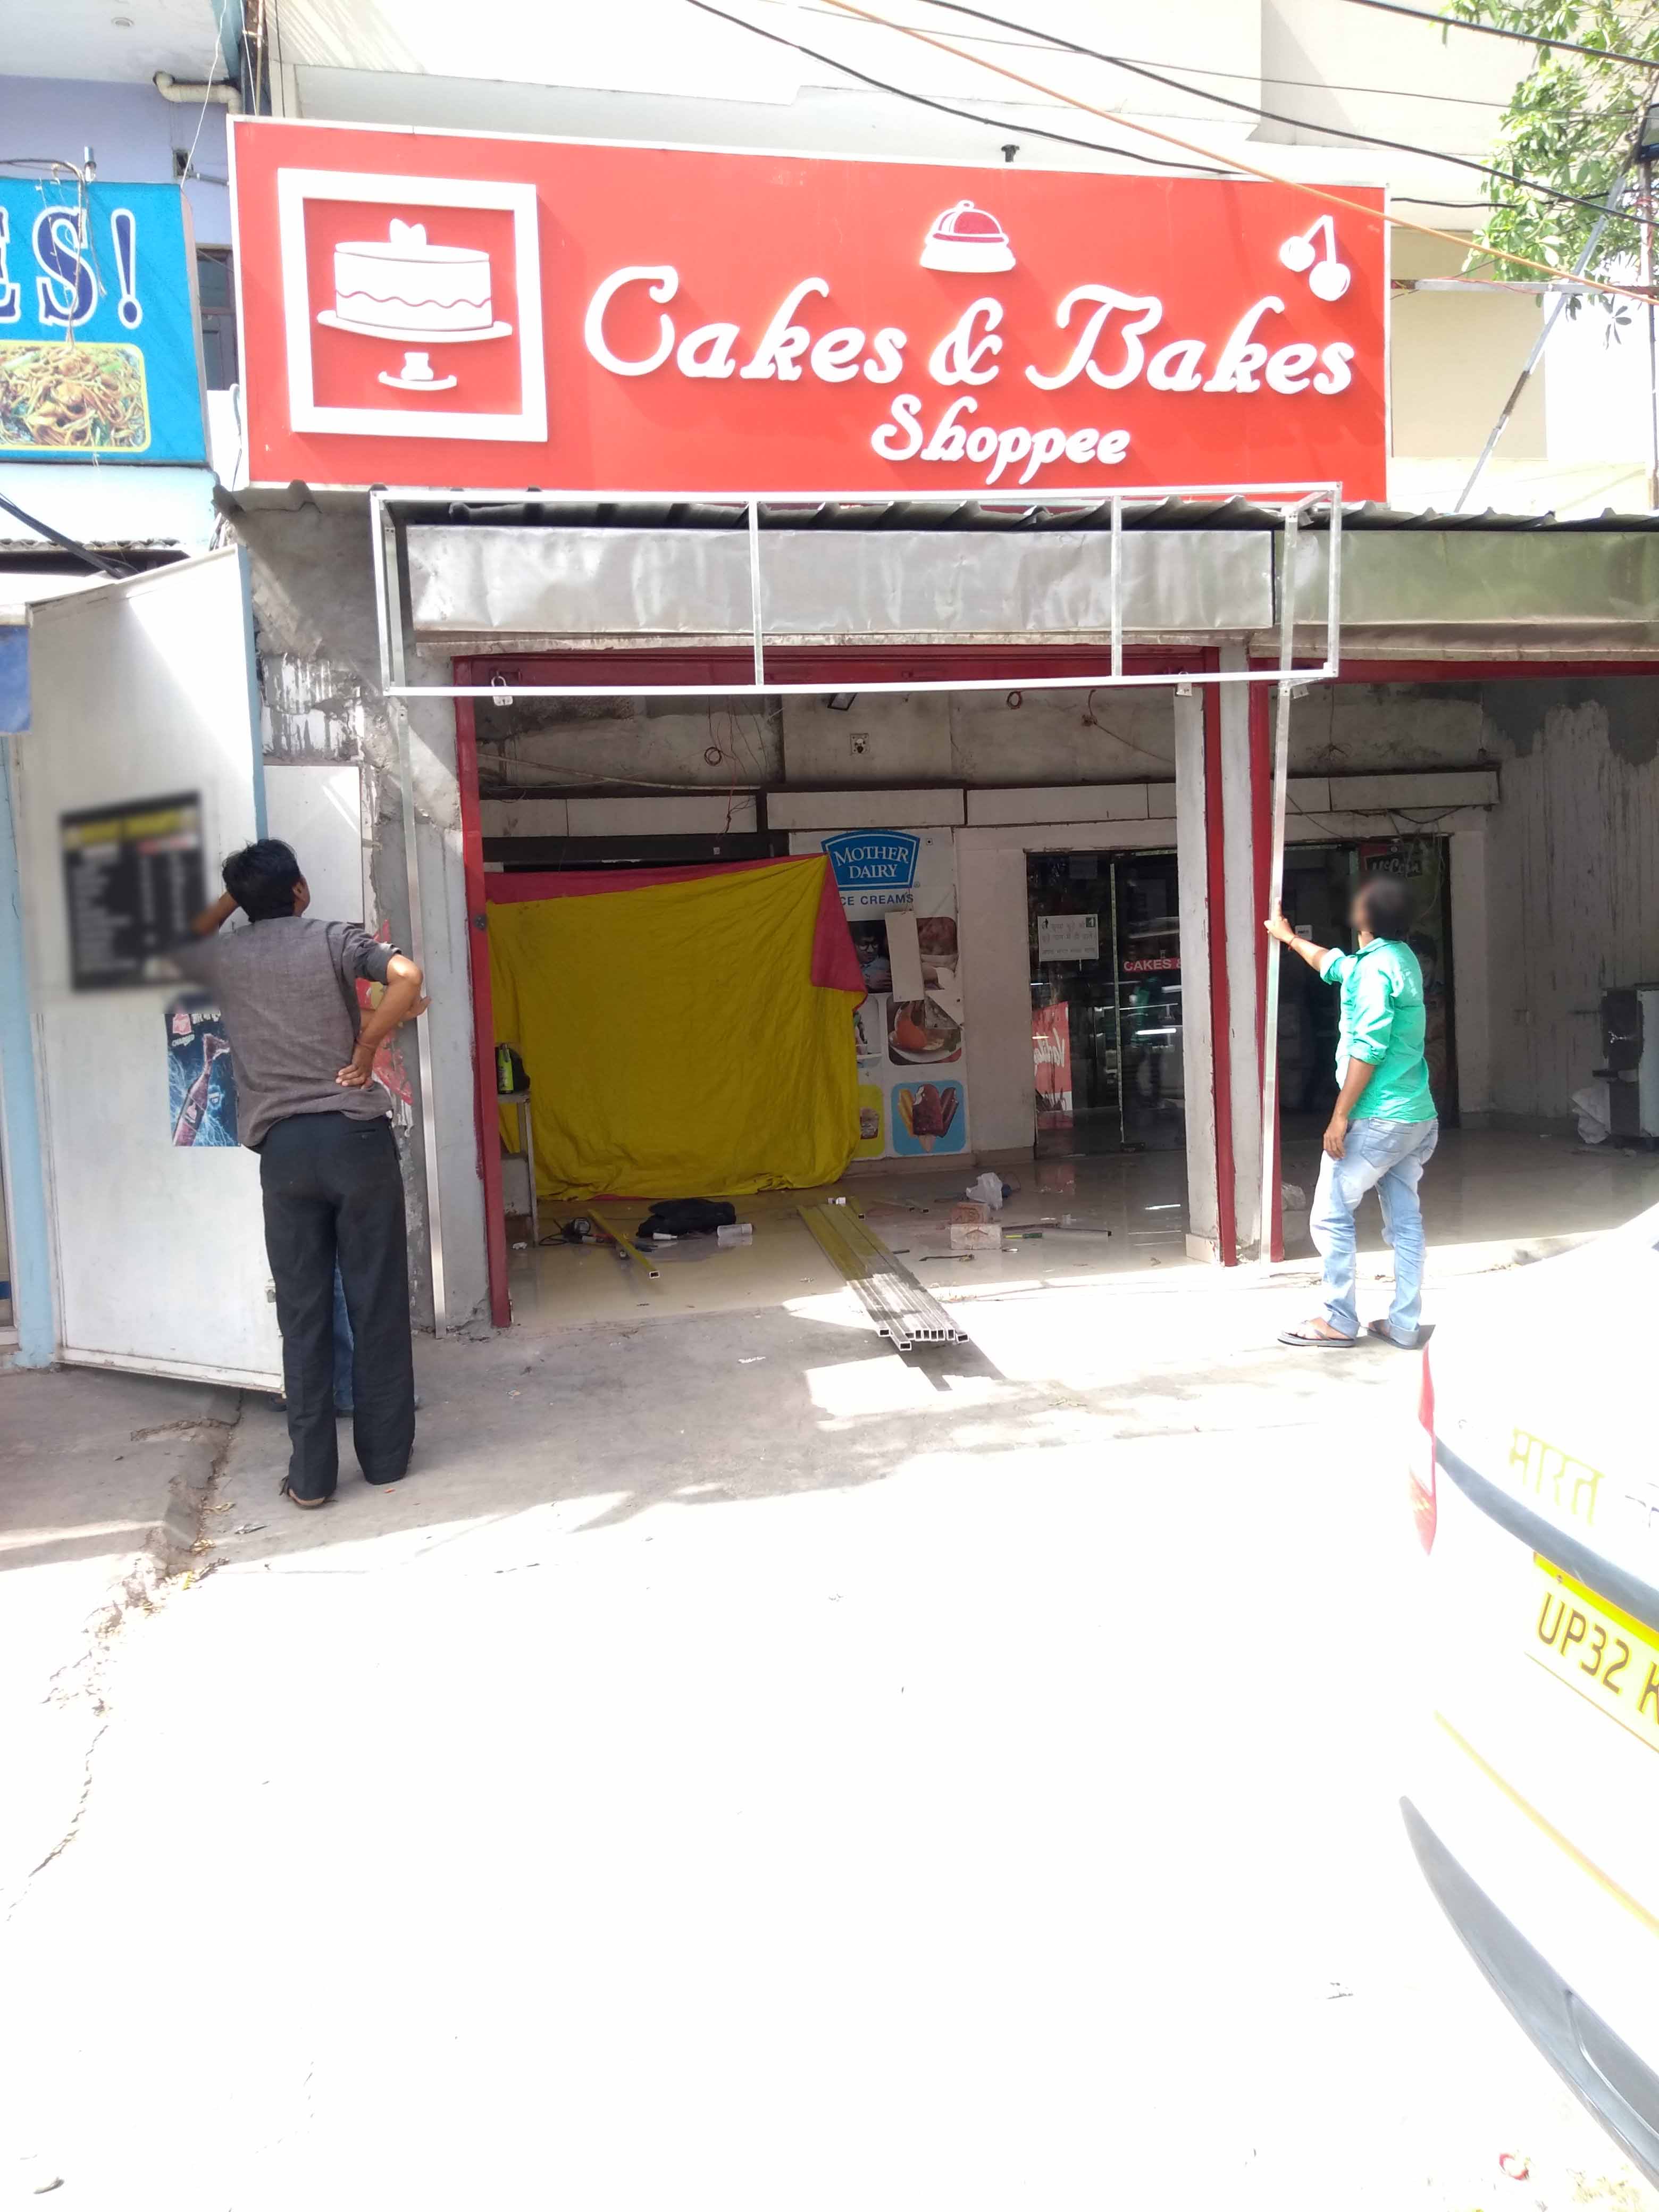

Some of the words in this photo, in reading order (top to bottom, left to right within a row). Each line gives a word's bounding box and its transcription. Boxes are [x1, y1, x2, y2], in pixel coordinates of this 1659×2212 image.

[584, 265, 907, 383] Cakes
[929, 297, 1003, 386] &
[1025, 284, 1355, 395] Bakes
[870, 393, 1130, 485] Shoppee
[833, 846, 909, 867] MOTHER
[849, 864, 898, 878] DAIRY
[840, 896, 854, 906] CE
[860, 894, 914, 905] CREAMS
[1124, 959, 1171, 971] CAKES
[1537, 1592, 1632, 1694] UP32
